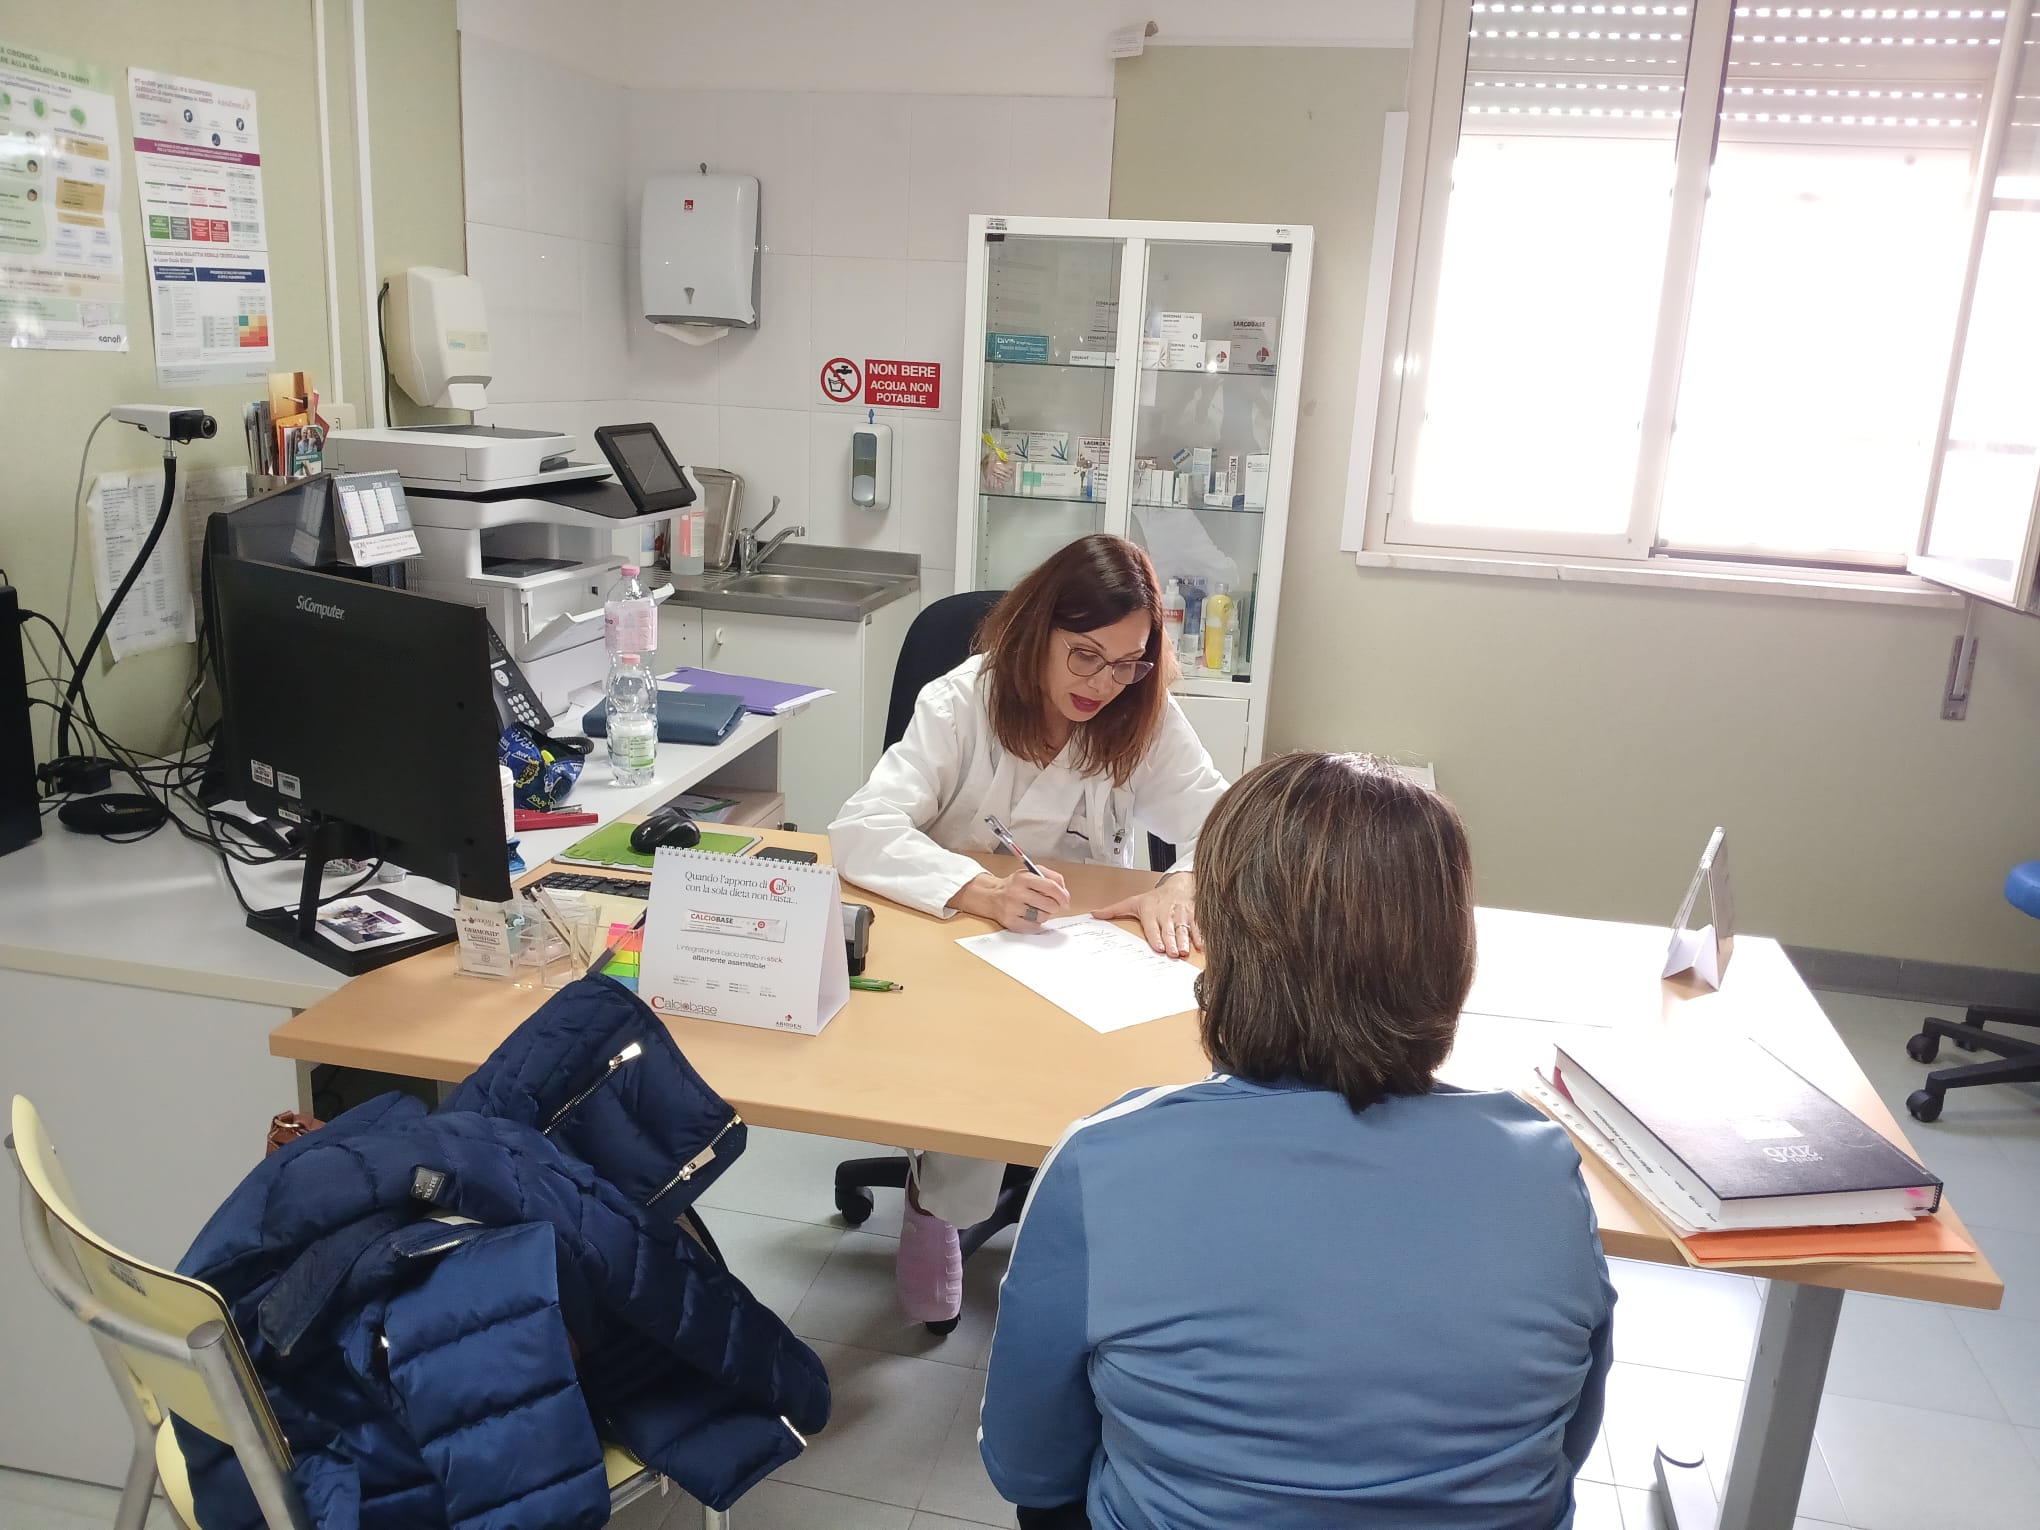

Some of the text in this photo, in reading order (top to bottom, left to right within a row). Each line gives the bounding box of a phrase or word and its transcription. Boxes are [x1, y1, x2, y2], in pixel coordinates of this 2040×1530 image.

[98, 334, 122, 344] sanofi
[869, 363, 936, 378] NON BERE
[870, 380, 933, 393] ACQUA NON
[876, 392, 927, 405] POTABILE
[296, 594, 345, 620] SiComputer
[684, 870, 796, 896] Quando l'apporto di Calcio
[685, 883, 798, 905] con la sola dieta non basta...
[690, 913, 734, 924] CALCIOBASE
[676, 943, 715, 956] L'integratore
[692, 954, 766, 970] altamente assimilabile
[651, 995, 718, 1015] Calciobase
